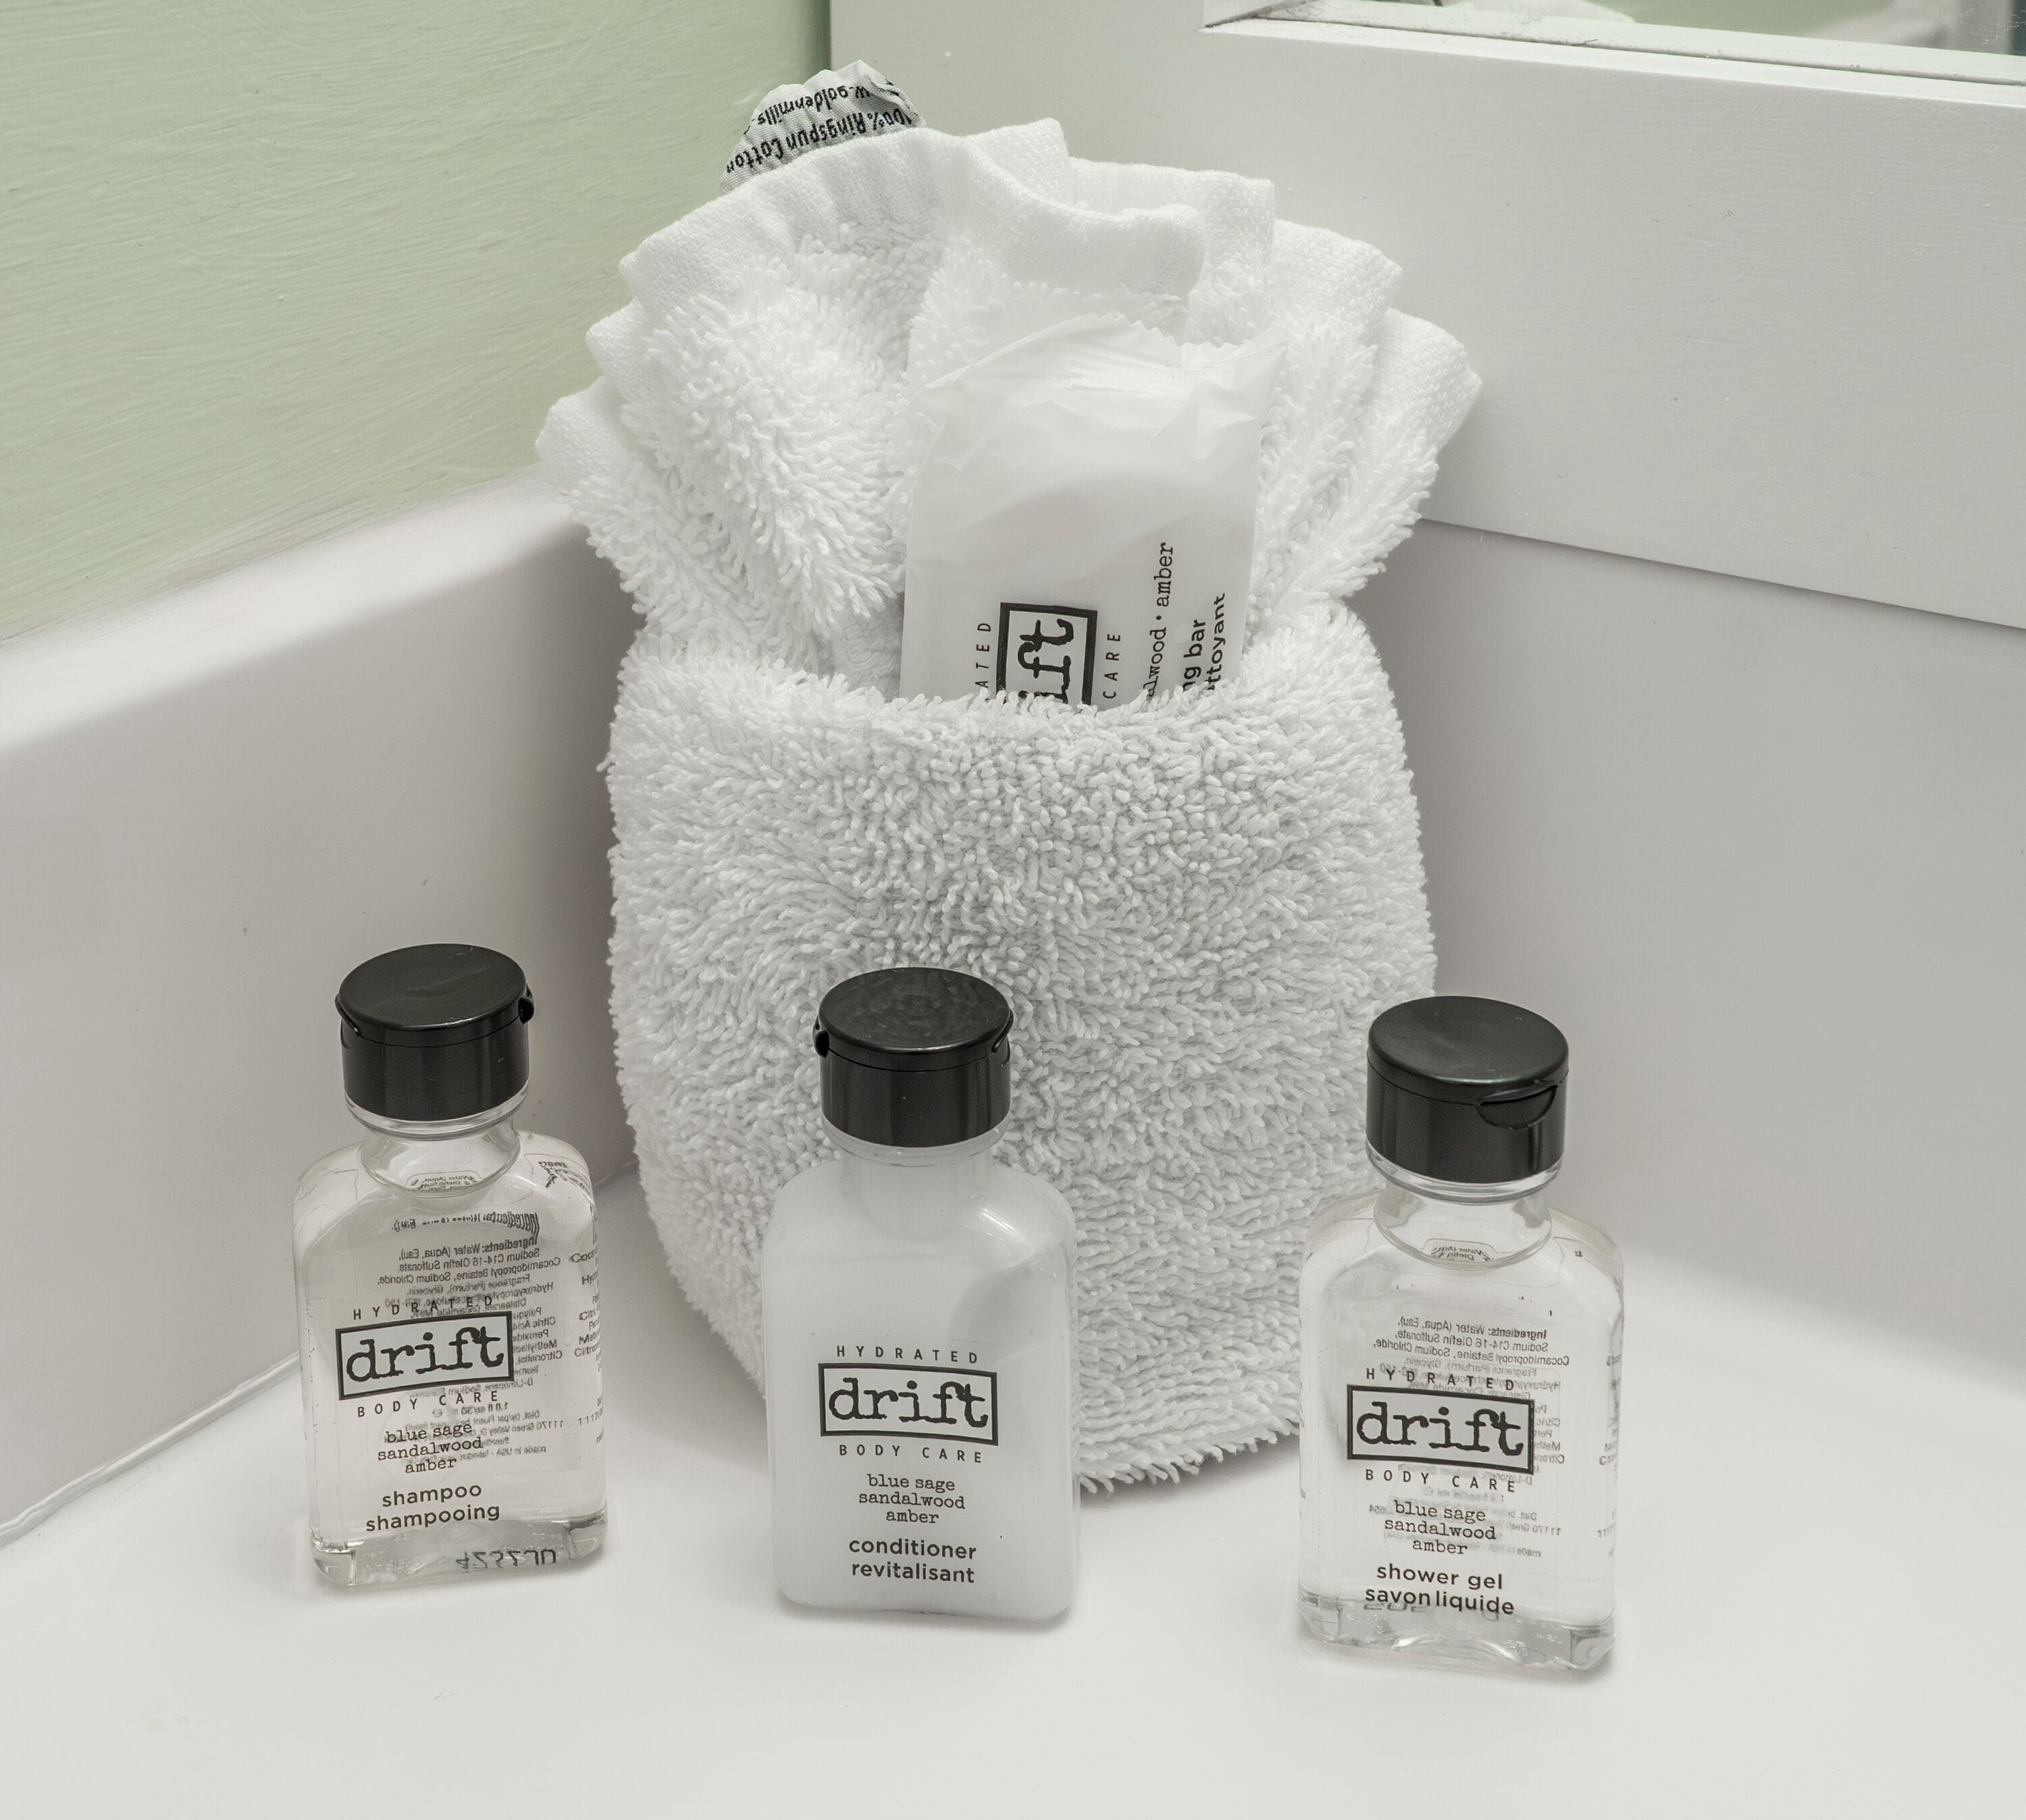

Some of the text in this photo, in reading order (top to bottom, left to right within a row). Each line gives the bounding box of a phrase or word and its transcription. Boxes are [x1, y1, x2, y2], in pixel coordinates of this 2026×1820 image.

[785, 113, 866, 150] Ringspun
[726, 137, 783, 173] Cotton
[1143, 542, 1174, 698] alwood amber
[1183, 619, 1206, 658] bar
[1205, 592, 1226, 685] ttoyant
[975, 622, 992, 688] ATED
[1017, 618, 1074, 704] ift
[1102, 633, 1121, 699] CARE
[353, 1295, 492, 1320] HYDRATED
[346, 1326, 504, 1382] drift
[837, 1345, 977, 1364] HYDRATED
[1366, 1368, 1514, 1391] HYDRATED
[357, 1399, 417, 1418] BODY
[439, 1391, 498, 1406] CARE
[829, 1378, 989, 1428] drift
[386, 1430, 427, 1443] blue
[433, 1422, 472, 1439] sage
[1357, 1401, 1524, 1457] drift
[378, 1436, 484, 1461] sandalwood
[839, 1445, 981, 1463] BODY CARE
[405, 1457, 457, 1474] amber
[867, 1474, 956, 1493] blue sage
[1366, 1469, 1429, 1484] BODY
[1452, 1475, 1515, 1492] CARE
[382, 1485, 482, 1507] shampoo
[859, 1492, 965, 1509] sandalwood
[366, 1504, 500, 1531] shampooing
[886, 1509, 939, 1524] amber
[1395, 1500, 1437, 1517] blue
[1444, 1507, 1486, 1524] sage
[1385, 1519, 1497, 1540] sandalwood
[849, 1538, 977, 1559] conditioner
[1412, 1540, 1467, 1555] amber
[852, 1562, 975, 1584] revitalisant
[1377, 1564, 1503, 1590] shower gel
[1366, 1588, 1430, 1607] savon
[1436, 1591, 1514, 1615] liquide
